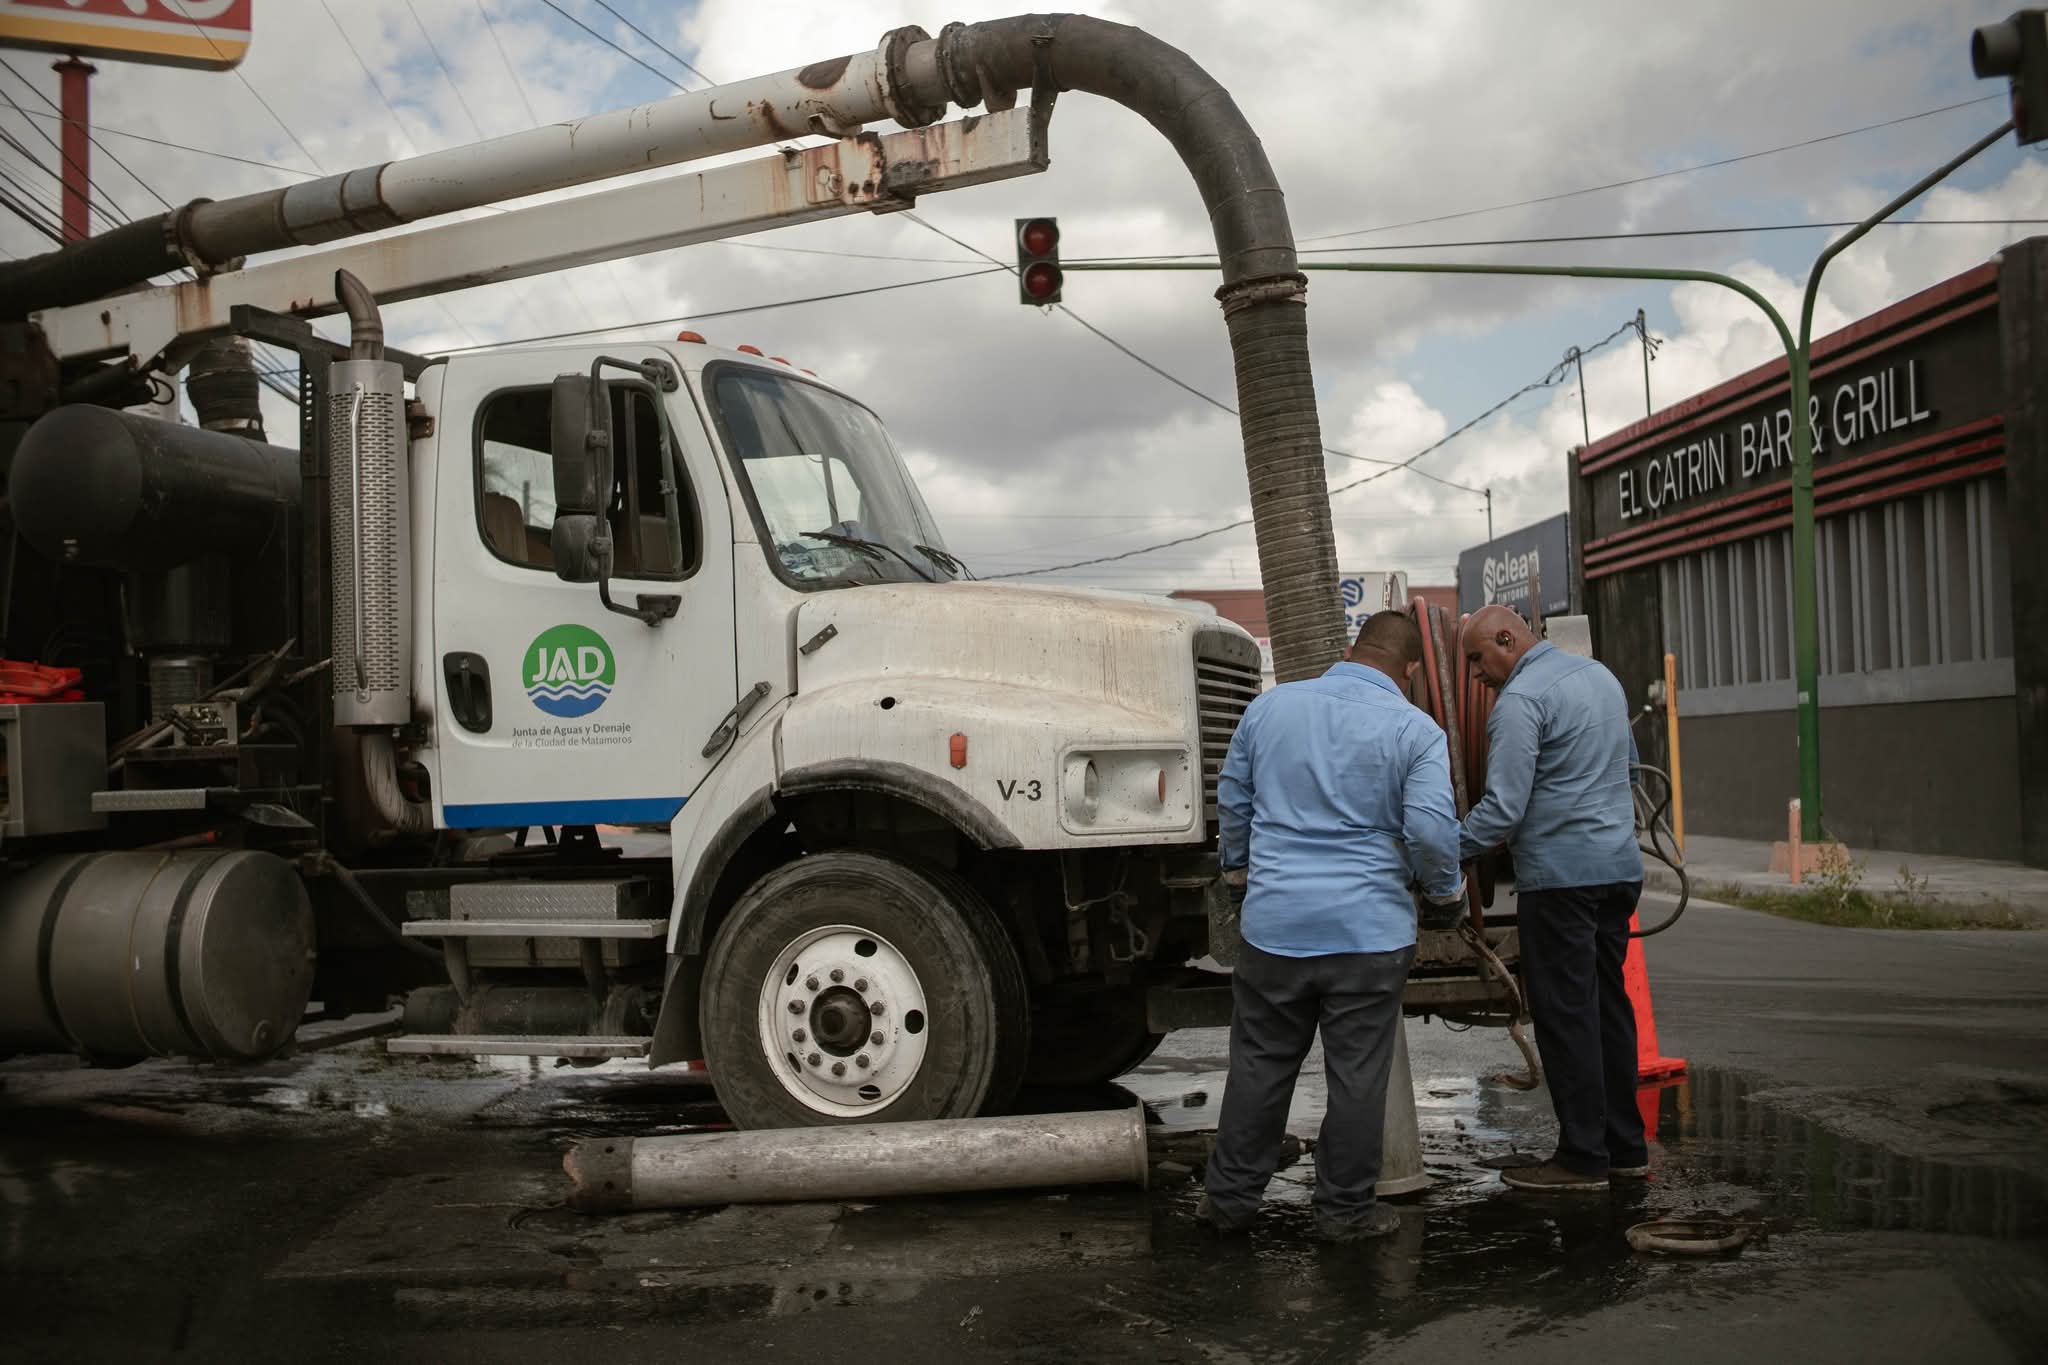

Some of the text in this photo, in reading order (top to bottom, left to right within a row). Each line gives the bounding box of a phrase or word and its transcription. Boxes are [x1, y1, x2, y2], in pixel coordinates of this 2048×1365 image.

[1619, 359, 1931, 520] EL CATRIN BAR & GRILL
[532, 647, 606, 681] JAD
[512, 723, 631, 737] Junta de Aguas y Drenaje
[512, 737, 632, 748] de la Ciudad de Matamoros
[996, 779, 1042, 801] V-3
